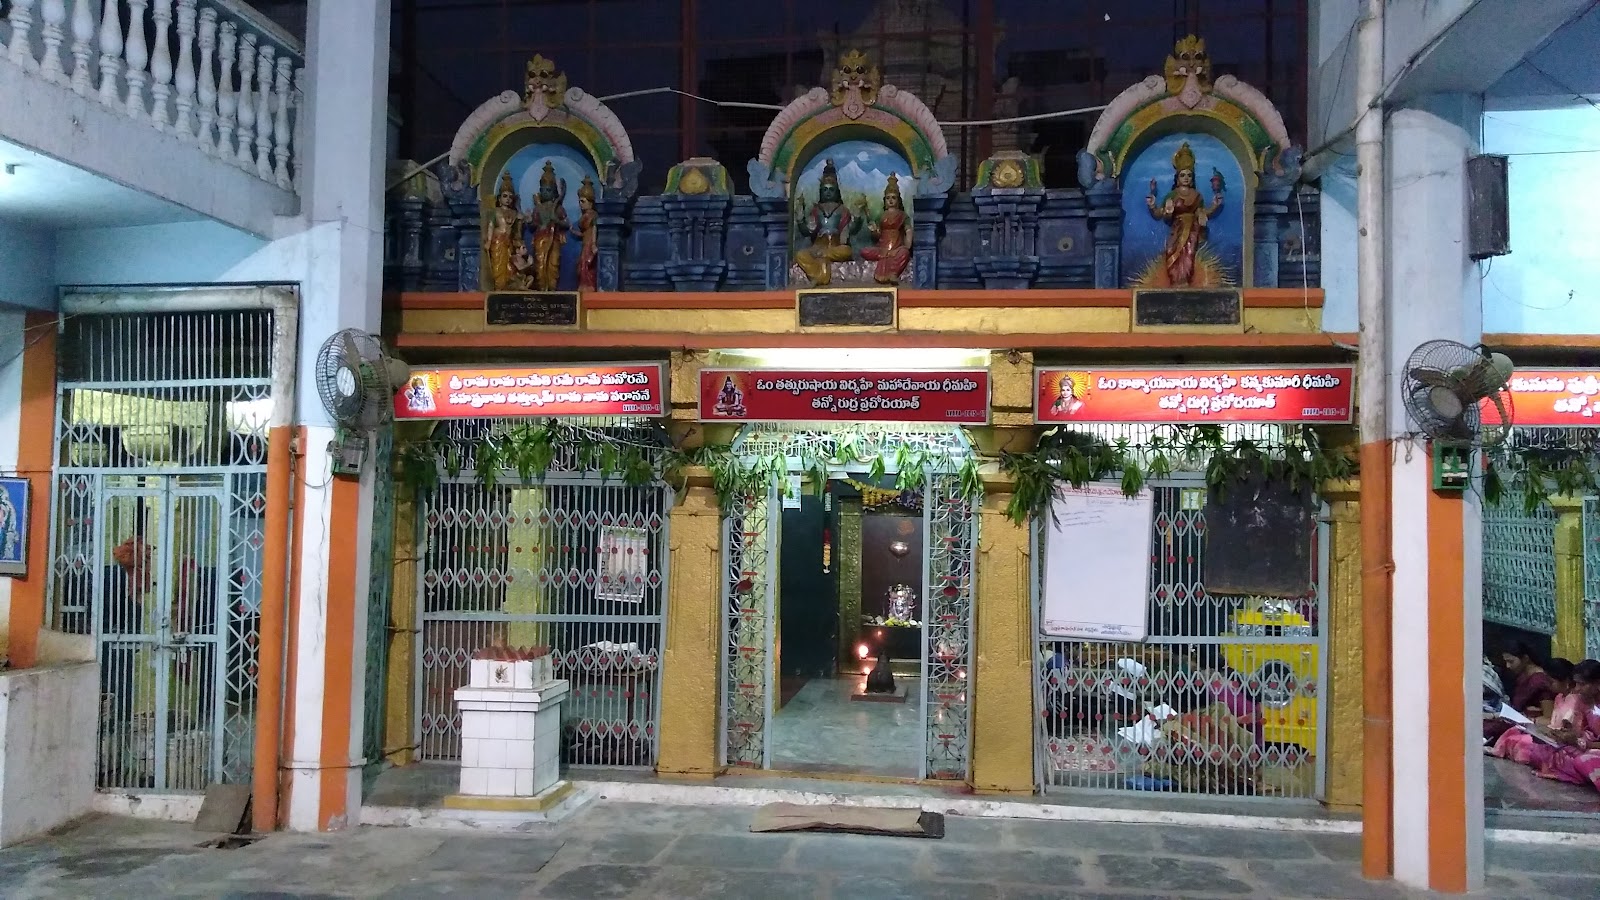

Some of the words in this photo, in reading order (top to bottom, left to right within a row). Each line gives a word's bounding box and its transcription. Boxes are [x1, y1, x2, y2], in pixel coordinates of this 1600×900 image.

[449, 375, 463, 390] శ్రీ
[463, 375, 489, 387] రామ
[489, 375, 516, 387] రామ
[516, 373, 552, 387] రామేతి
[552, 373, 574, 386] రమే
[575, 373, 601, 386] రామే
[602, 371, 649, 385] మనోరమే
[756, 378, 774, 390] ఓం
[775, 378, 837, 395] తత్పురుషాయ
[839, 377, 874, 394] విద్మహే
[876, 377, 941, 391] మహాదేవాయ
[942, 378, 977, 393] ధీమహి
[1098, 376, 1117, 389] ఓం
[1199, 373, 1238, 393] విద్మహే
[1302, 374, 1340, 390] ధీమహి
[555, 391, 582, 402] రామ
[610, 388, 651, 402] వరాననే
[811, 394, 838, 412] తన్నో
[837, 397, 858, 412] రుద్ర
[860, 395, 920, 412] ప్రచోదయాత్
[1158, 393, 1187, 413] తన్నో
[1210, 392, 1277, 412] ప్రచోదయాత్
